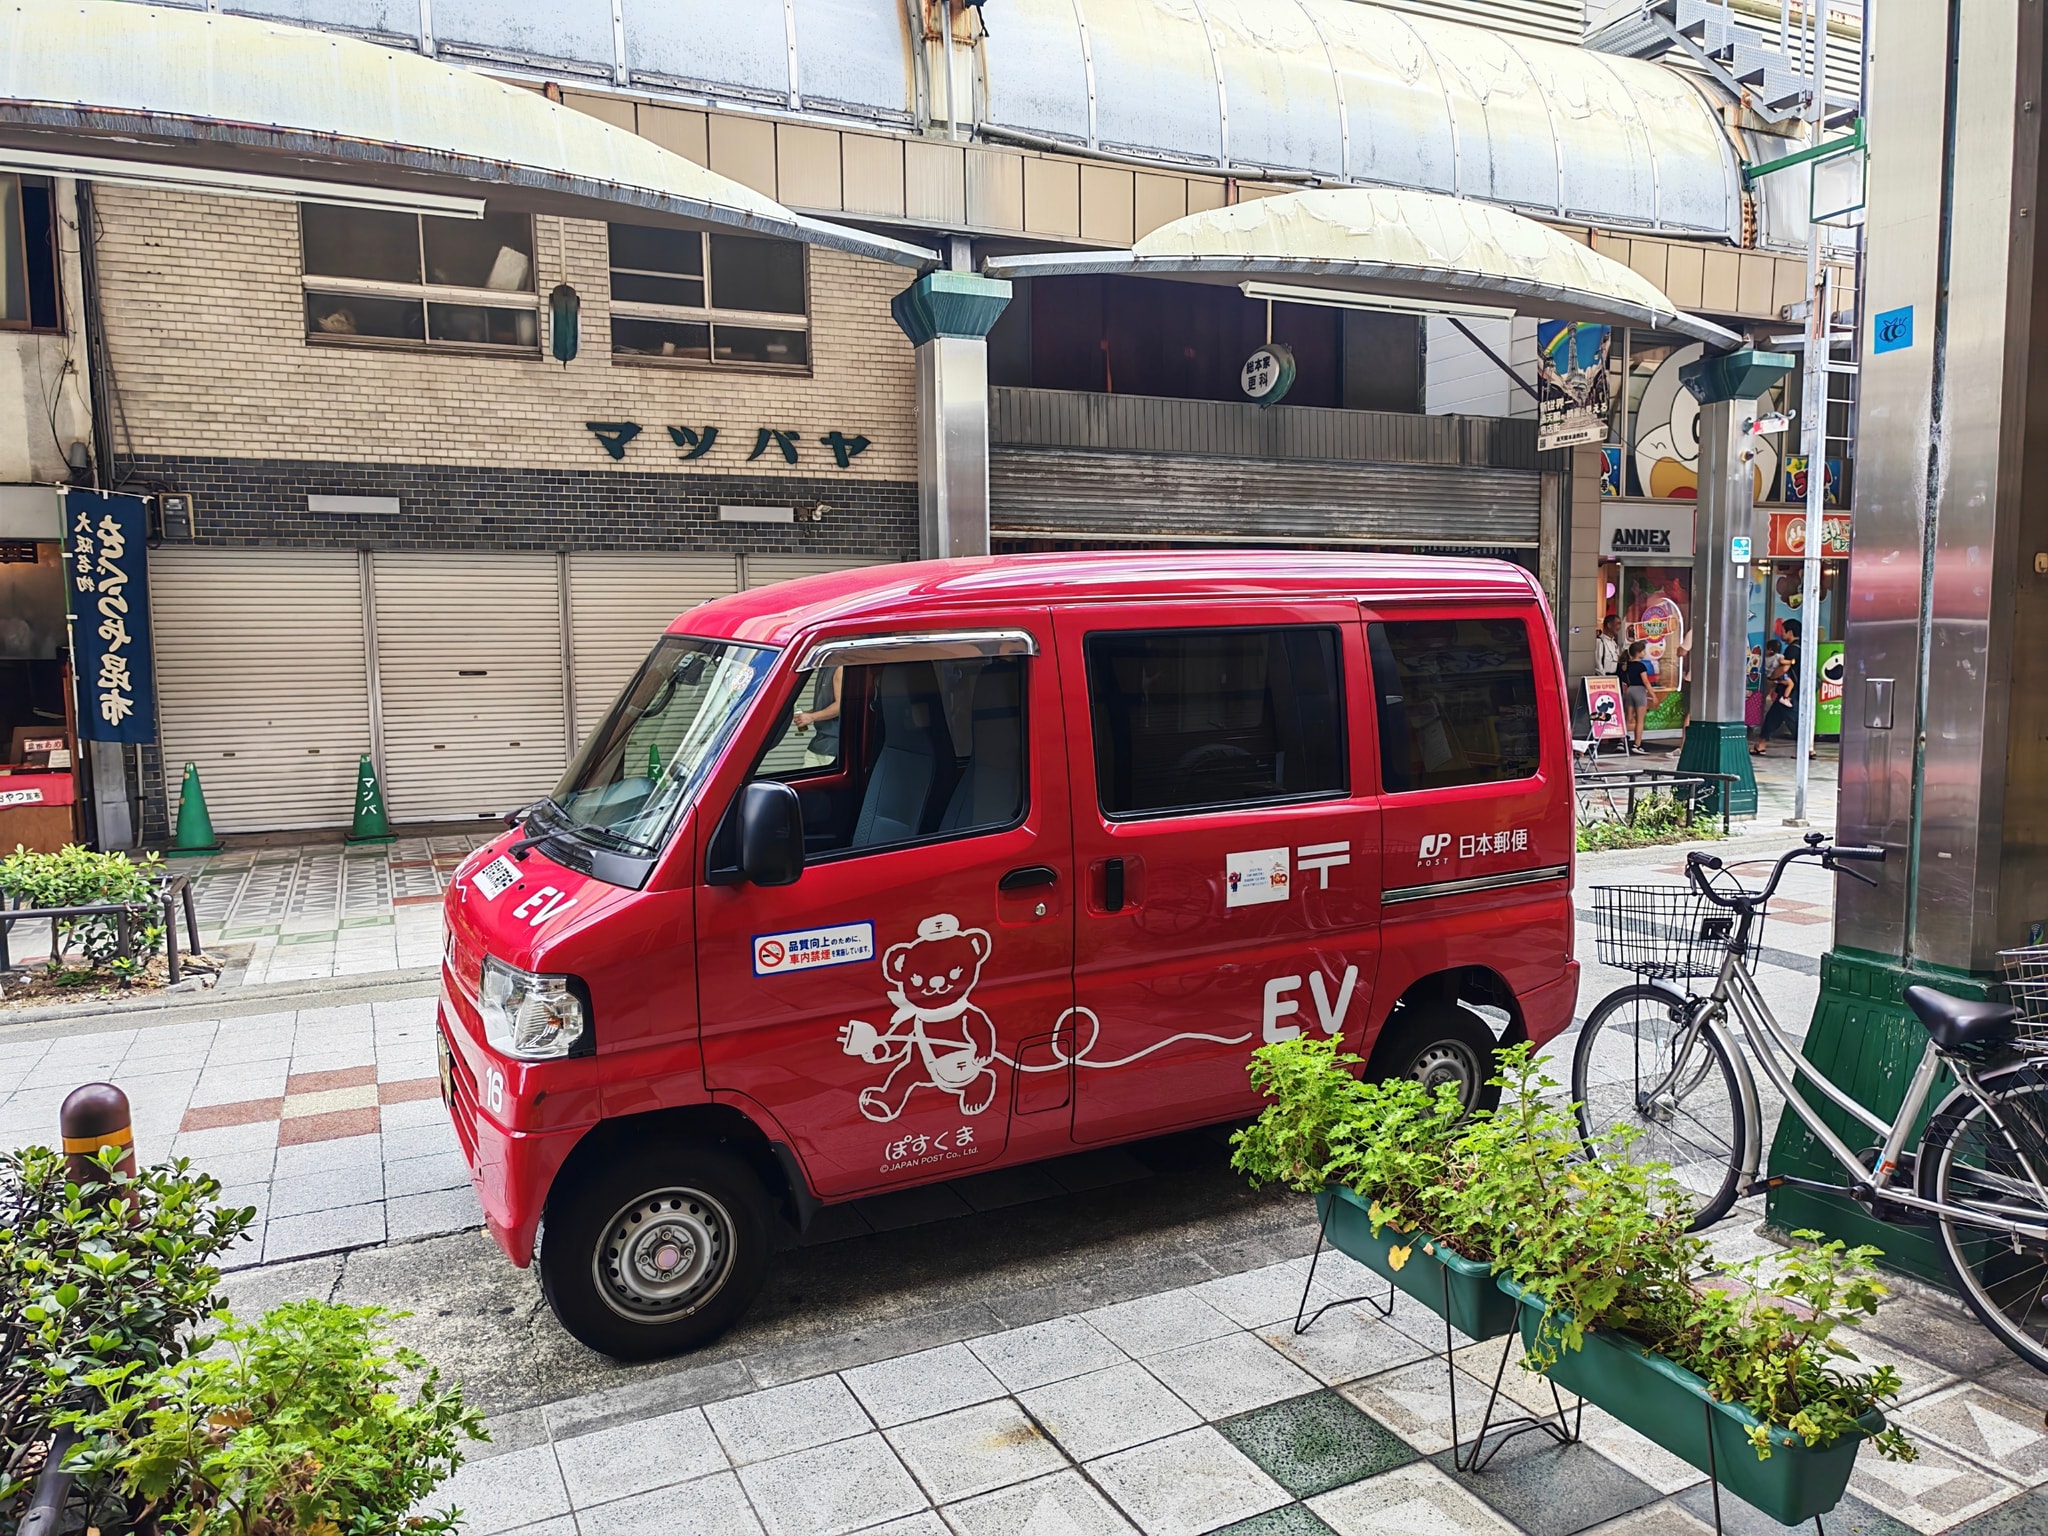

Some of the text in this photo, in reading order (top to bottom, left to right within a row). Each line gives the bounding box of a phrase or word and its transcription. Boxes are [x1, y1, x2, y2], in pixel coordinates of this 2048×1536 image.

[1246, 356, 1271, 374] 総本家
[1247, 371, 1268, 391] 更科
[586, 422, 871, 468] マツバヤ
[1612, 529, 1670, 545] ANNEX
[361, 777, 377, 815] マンバ
[1459, 829, 1528, 858] 日本郵便
[1417, 857, 1449, 868] POST
[513, 886, 578, 926] EV
[789, 936, 861, 952] 品質向上のために、
[1262, 965, 1358, 1044] EV
[486, 1066, 504, 1113] 16
[885, 1126, 974, 1160] ぽすくま
[921, 1153, 944, 1165] POST
[963, 1146, 979, 1156] Ltd.
